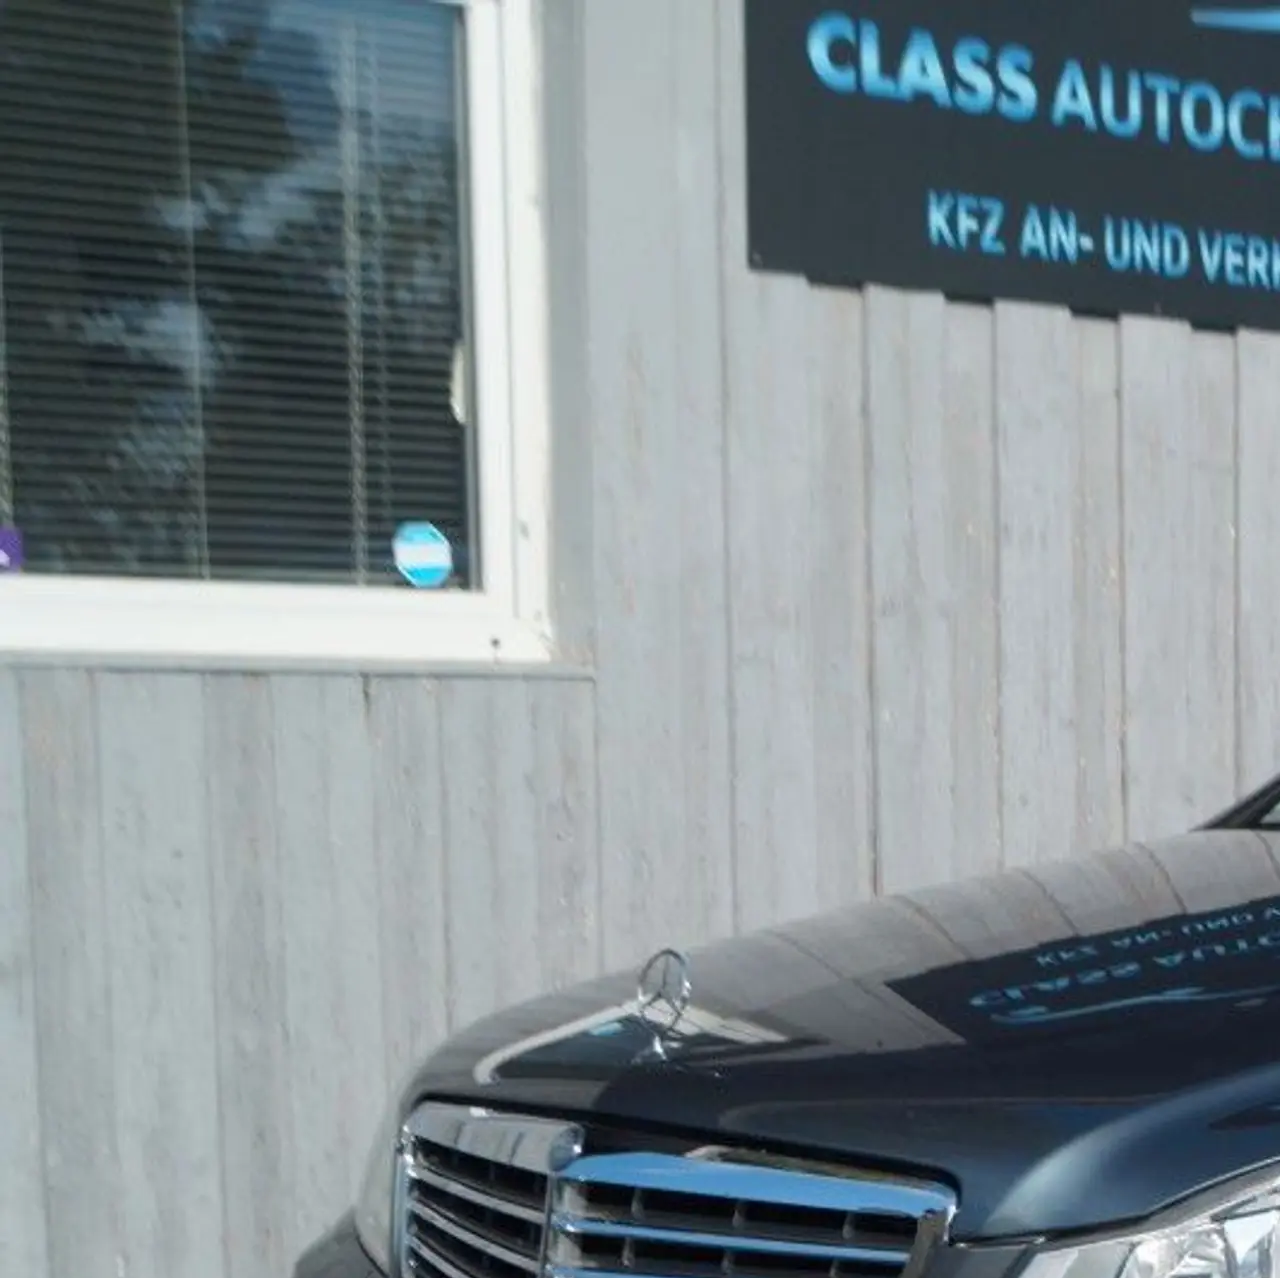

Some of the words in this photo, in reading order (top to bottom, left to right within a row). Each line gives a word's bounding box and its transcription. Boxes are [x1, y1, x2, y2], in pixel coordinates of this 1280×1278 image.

[806, 11, 1038, 122] CLASS
[928, 189, 1004, 255] KFZ
[1020, 204, 1094, 260] AN-
[1104, 216, 1190, 278] UND
